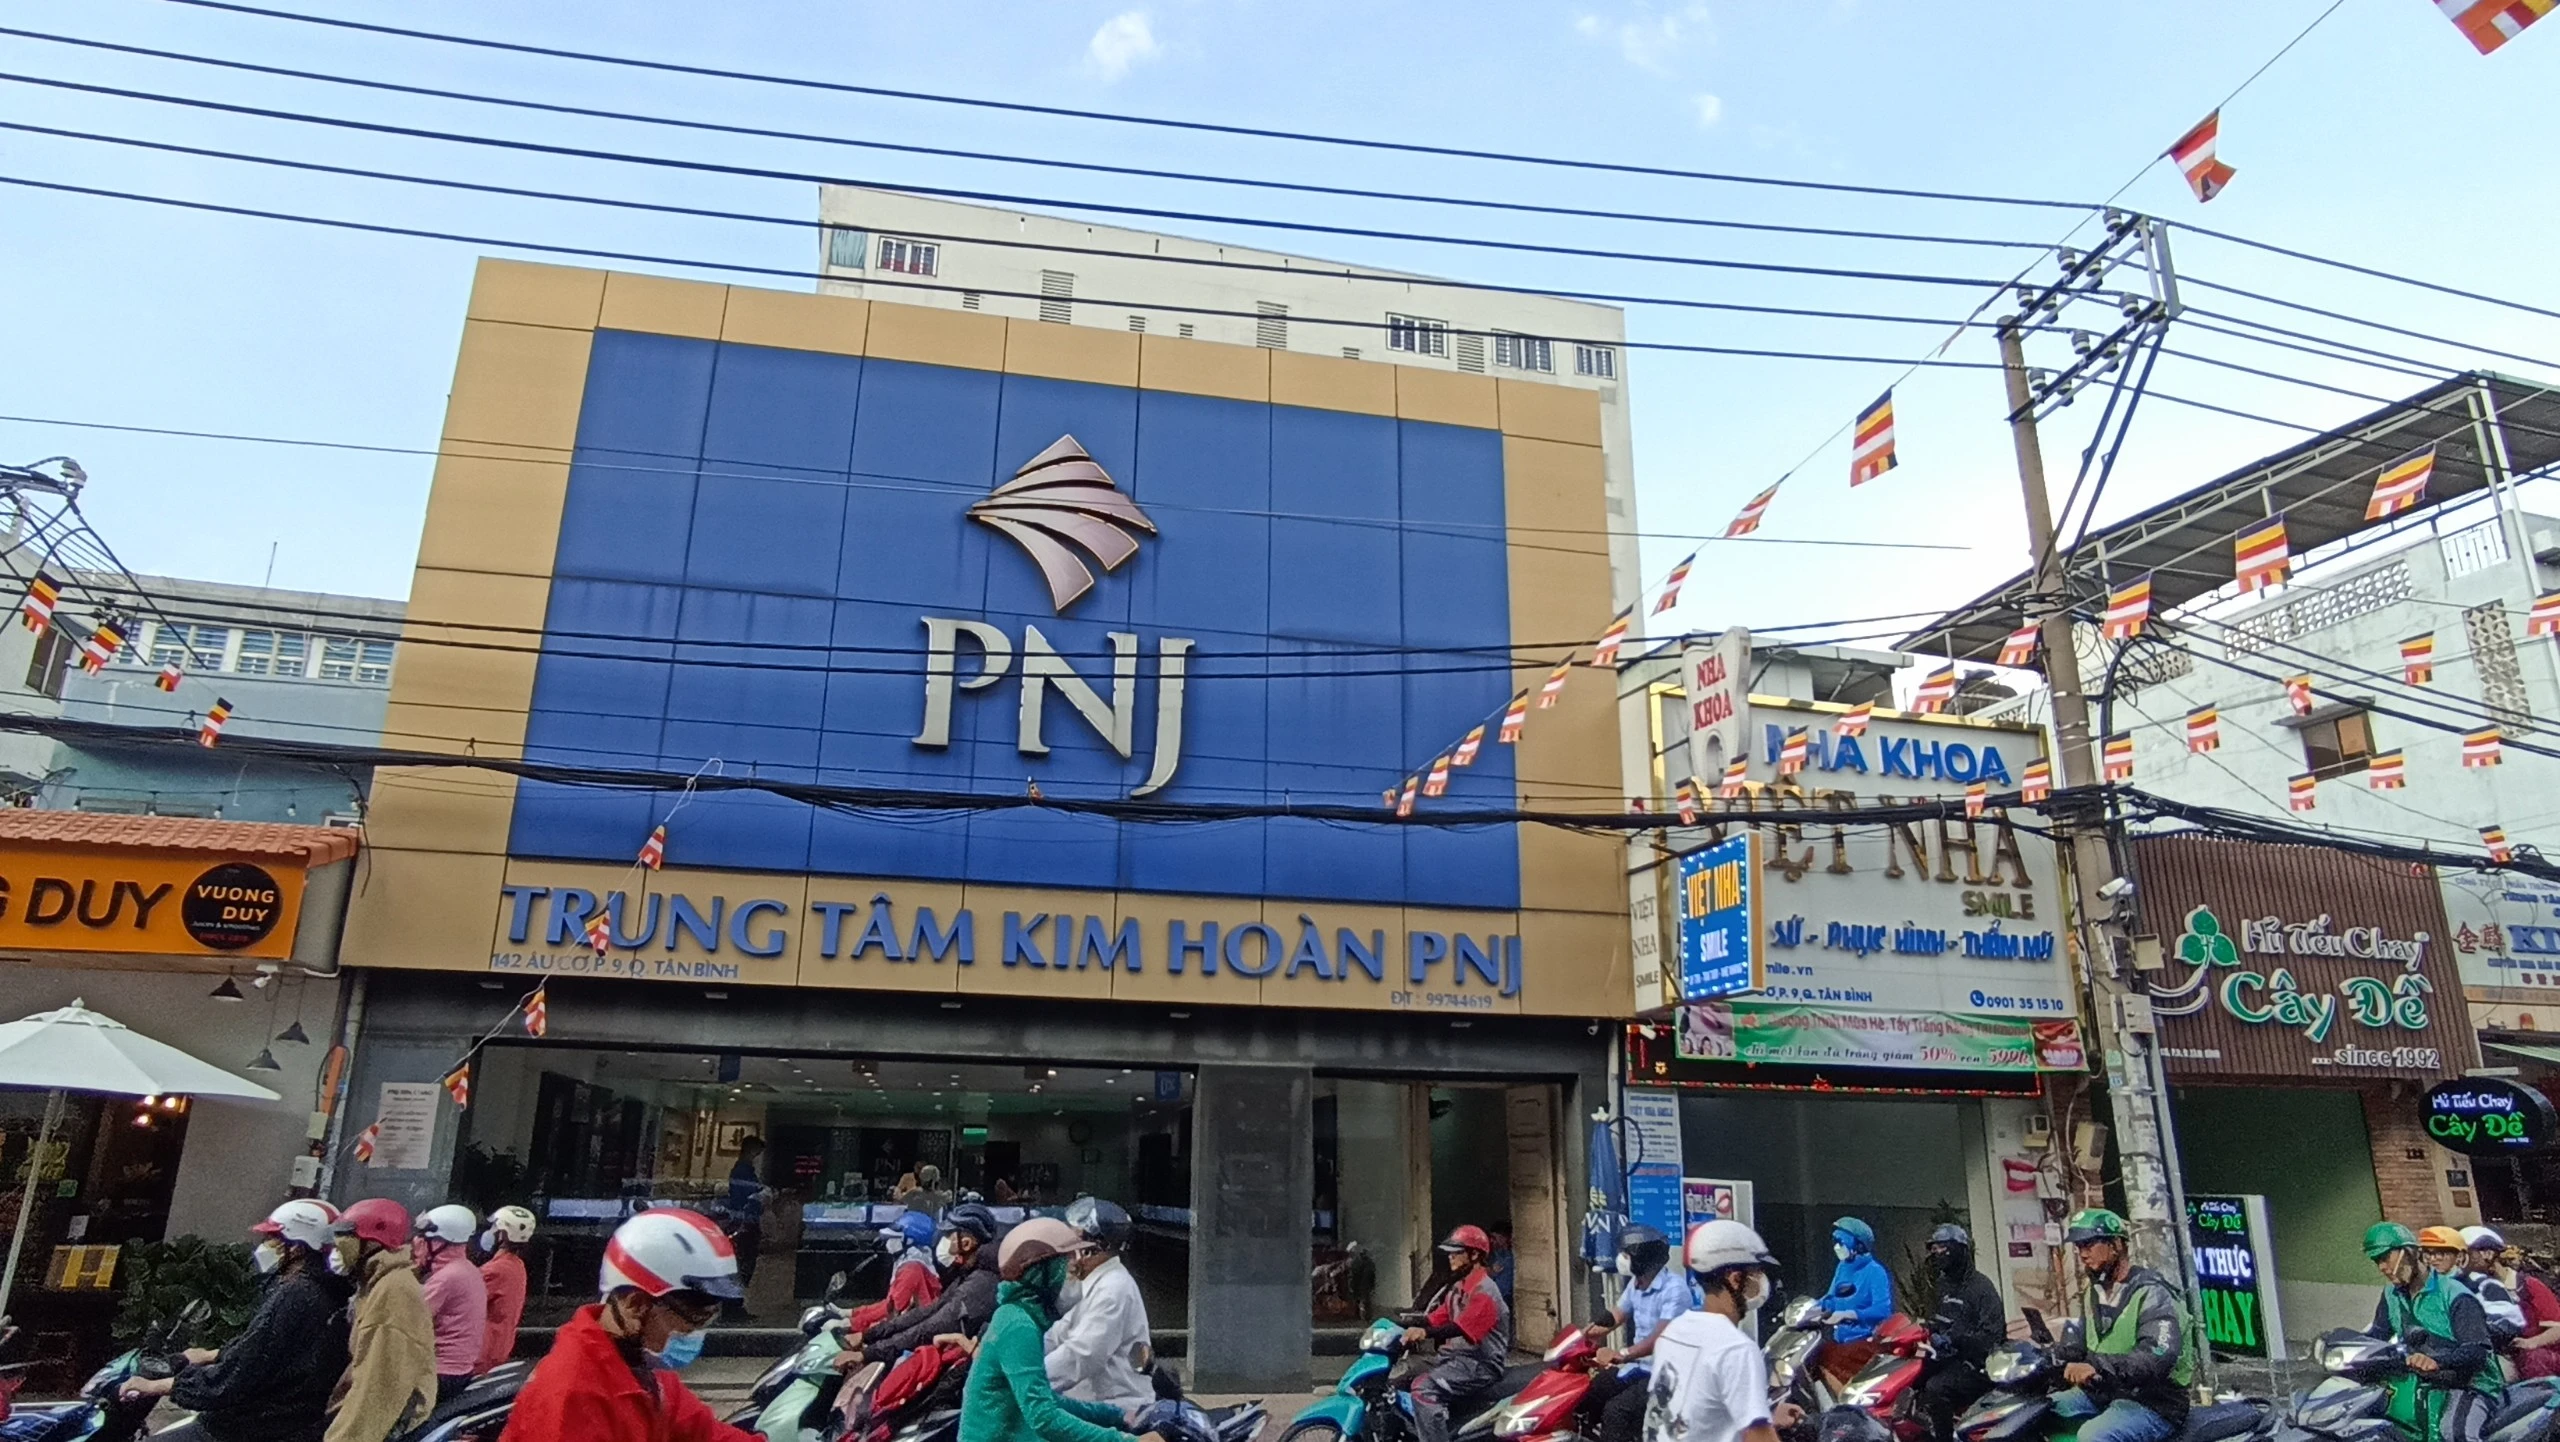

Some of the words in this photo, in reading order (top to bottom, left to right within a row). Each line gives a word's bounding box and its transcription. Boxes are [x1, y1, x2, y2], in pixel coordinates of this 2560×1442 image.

[1696, 652, 1727, 691] NHA
[911, 616, 1195, 799] PNJ
[1693, 688, 1733, 731] KHOA
[1763, 723, 1869, 774] NHA
[1877, 735, 2012, 786] KHOA
[24, 877, 174, 930] DUY
[198, 885, 275, 903] VUONG
[1630, 893, 1655, 923] VIỆT
[1687, 862, 1711, 926] VIỆT
[1714, 860, 1741, 911] NHA
[1961, 890, 2036, 921] SMILE
[222, 906, 269, 922] DUY
[501, 884, 789, 958] TRUNG
[812, 891, 975, 965] TÂM
[1002, 910, 1142, 972] KIM
[1168, 914, 1384, 985] HOÀN
[1408, 930, 1522, 997] PNJ
[1632, 933, 1657, 959] NHA
[1701, 927, 1729, 962] SMILE
[1892, 920, 1946, 956] HÌNH
[2019, 930, 2054, 962] MỸ
[2343, 927, 2430, 971] Chay
[493, 953, 521, 968] 142
[526, 956, 553, 971] ÂU
[655, 957, 691, 976] TÂN
[694, 959, 739, 978] BÌNH
[1636, 970, 1659, 988] SMILE
[1818, 987, 1841, 1000] TÂN
[1844, 987, 1873, 1002] BÌNH
[1986, 996, 2015, 1008] 0901
[2019, 997, 2034, 1009] 35
[2036, 998, 2049, 1010] 15
[2051, 999, 2064, 1011] 10
[2221, 968, 2336, 1043] Cây
[2339, 973, 2434, 1029] Đề
[1920, 1046, 1957, 1062] 50%
[2393, 1047, 2440, 1068] 1992
[2478, 1092, 2514, 1111] Chay
[2428, 1113, 2477, 1142] Cây
[2206, 1244, 2251, 1286] THỰC
[2201, 1288, 2256, 1346] HAY
